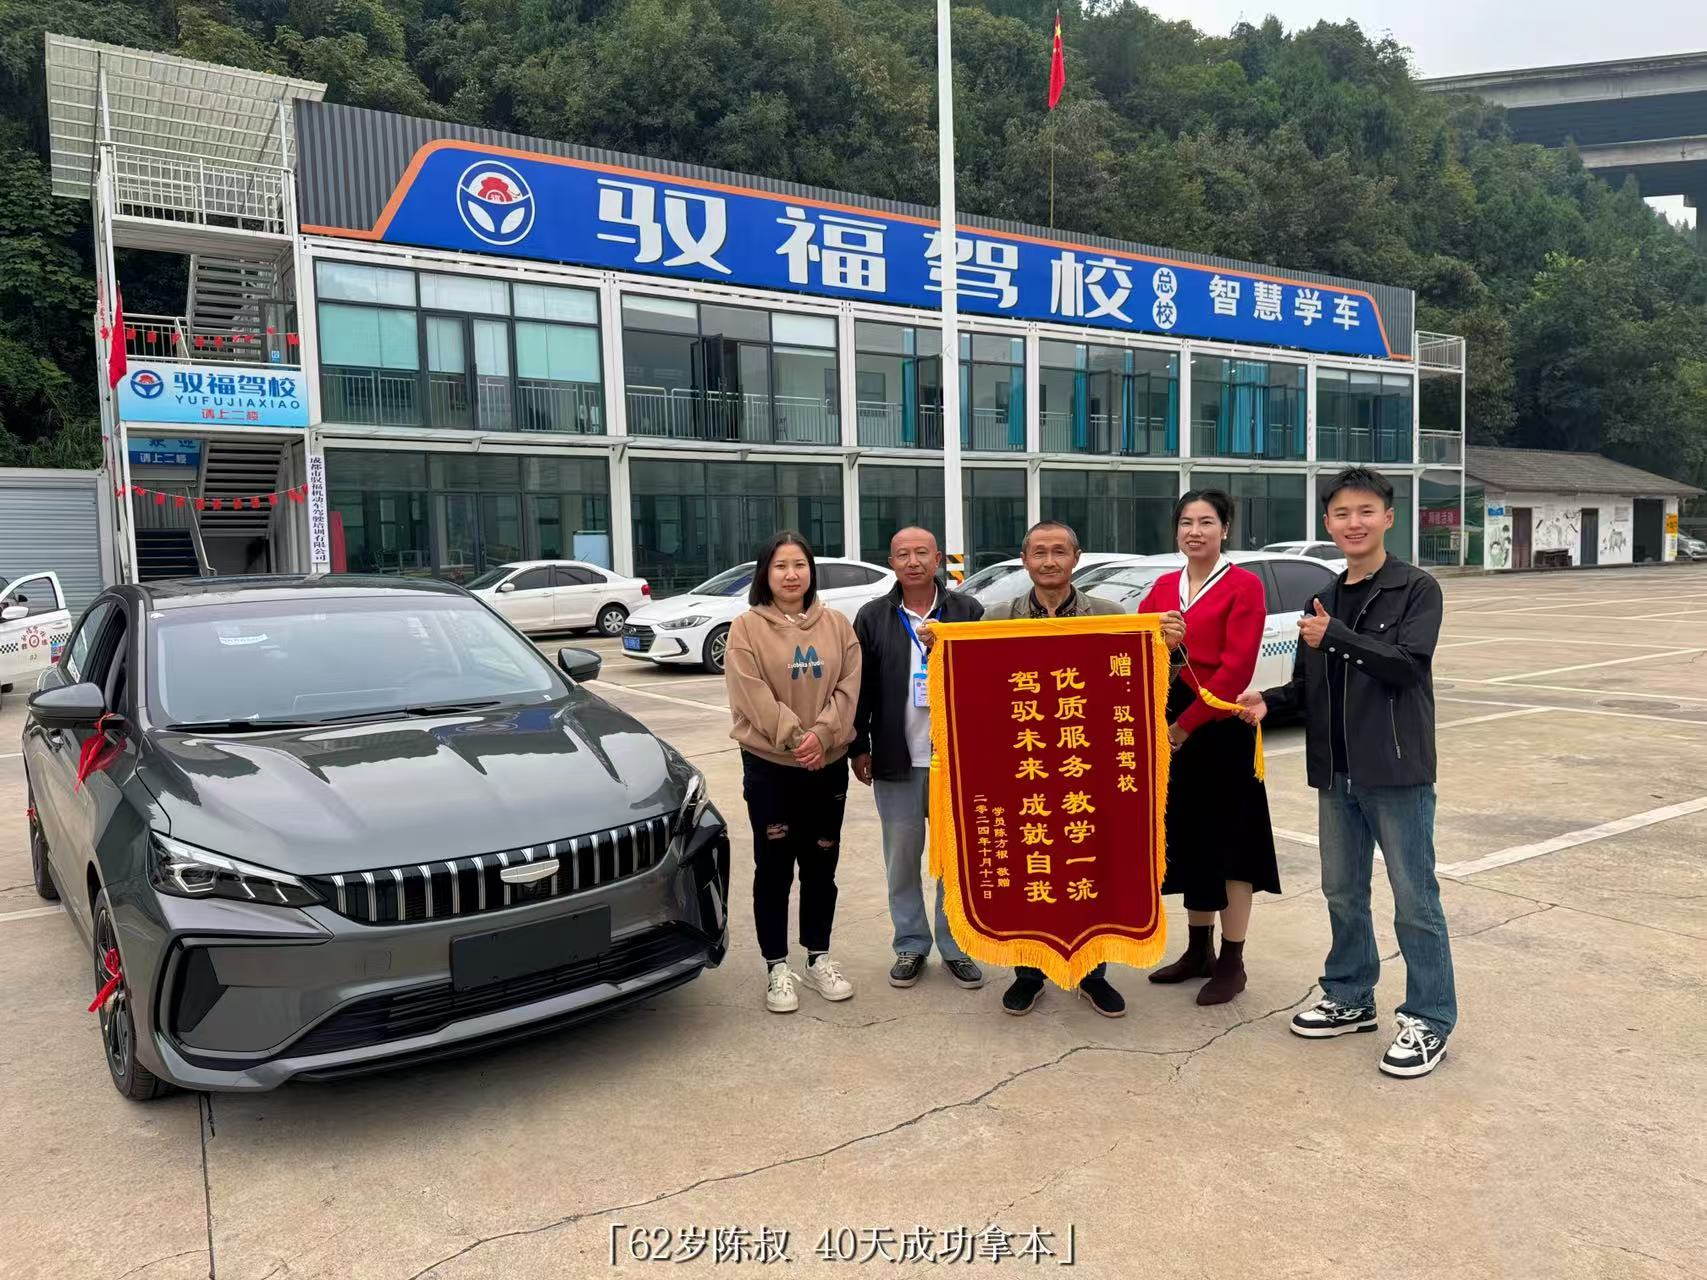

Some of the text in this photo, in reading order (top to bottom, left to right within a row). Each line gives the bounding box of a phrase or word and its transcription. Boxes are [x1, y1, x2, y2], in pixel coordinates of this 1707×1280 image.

[597, 178, 1133, 324] 驭福驾校
[1156, 269, 1174, 325] 总校
[1209, 274, 1361, 331] 智慧学车
[174, 371, 297, 399] 驭福驾校
[175, 394, 301, 409] YUFUJIAXIAO
[202, 408, 260, 421] 请上二楼
[140, 452, 188, 465] 请上二楼
[310, 457, 326, 562] 成都市驭福机动车驾驶培训有限公司
[973, 794, 994, 899] 二零二四年十月十二日
